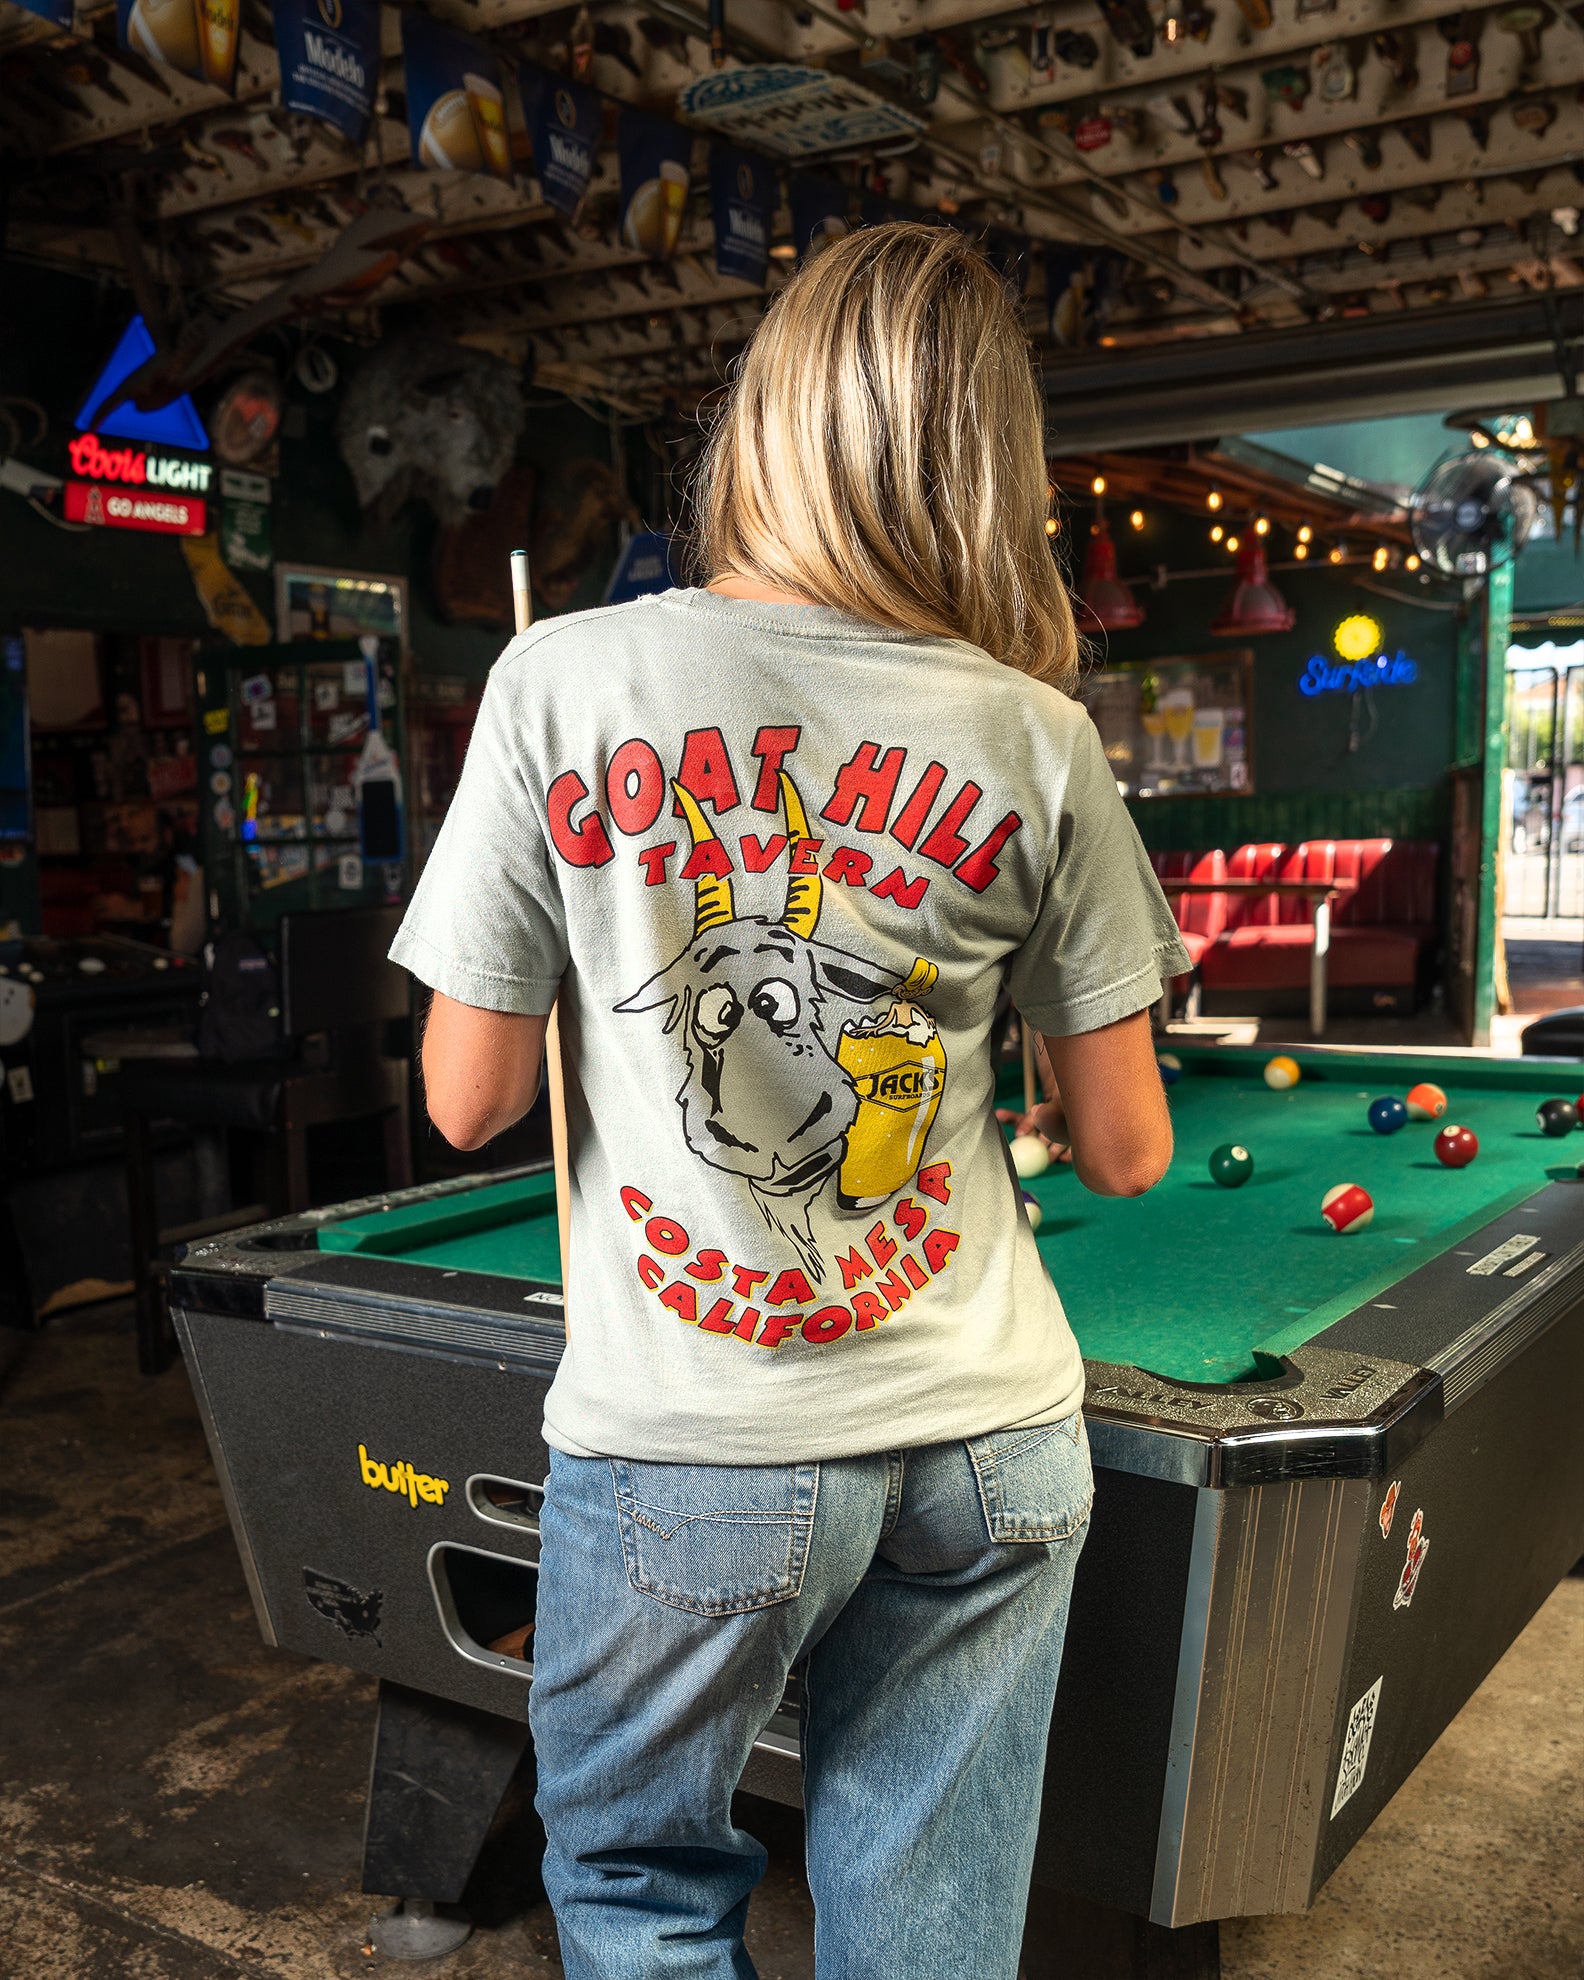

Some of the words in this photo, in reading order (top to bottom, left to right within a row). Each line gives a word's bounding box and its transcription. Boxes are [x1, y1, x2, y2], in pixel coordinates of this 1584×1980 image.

[146, 456, 213, 491] LIGHT
[107, 496, 134, 517] GO
[133, 501, 189, 525] ANGELS
[1299, 649, 1418, 696] Surfside
[547, 725, 802, 869] GOAT
[819, 740, 1023, 894] HILL
[638, 832, 931, 910] TAVERN
[620, 1185, 817, 1306] COSTA
[834, 1161, 953, 1290] MESA
[637, 1227, 960, 1349] CALIFORNIA
[357, 1443, 450, 1509] butter
